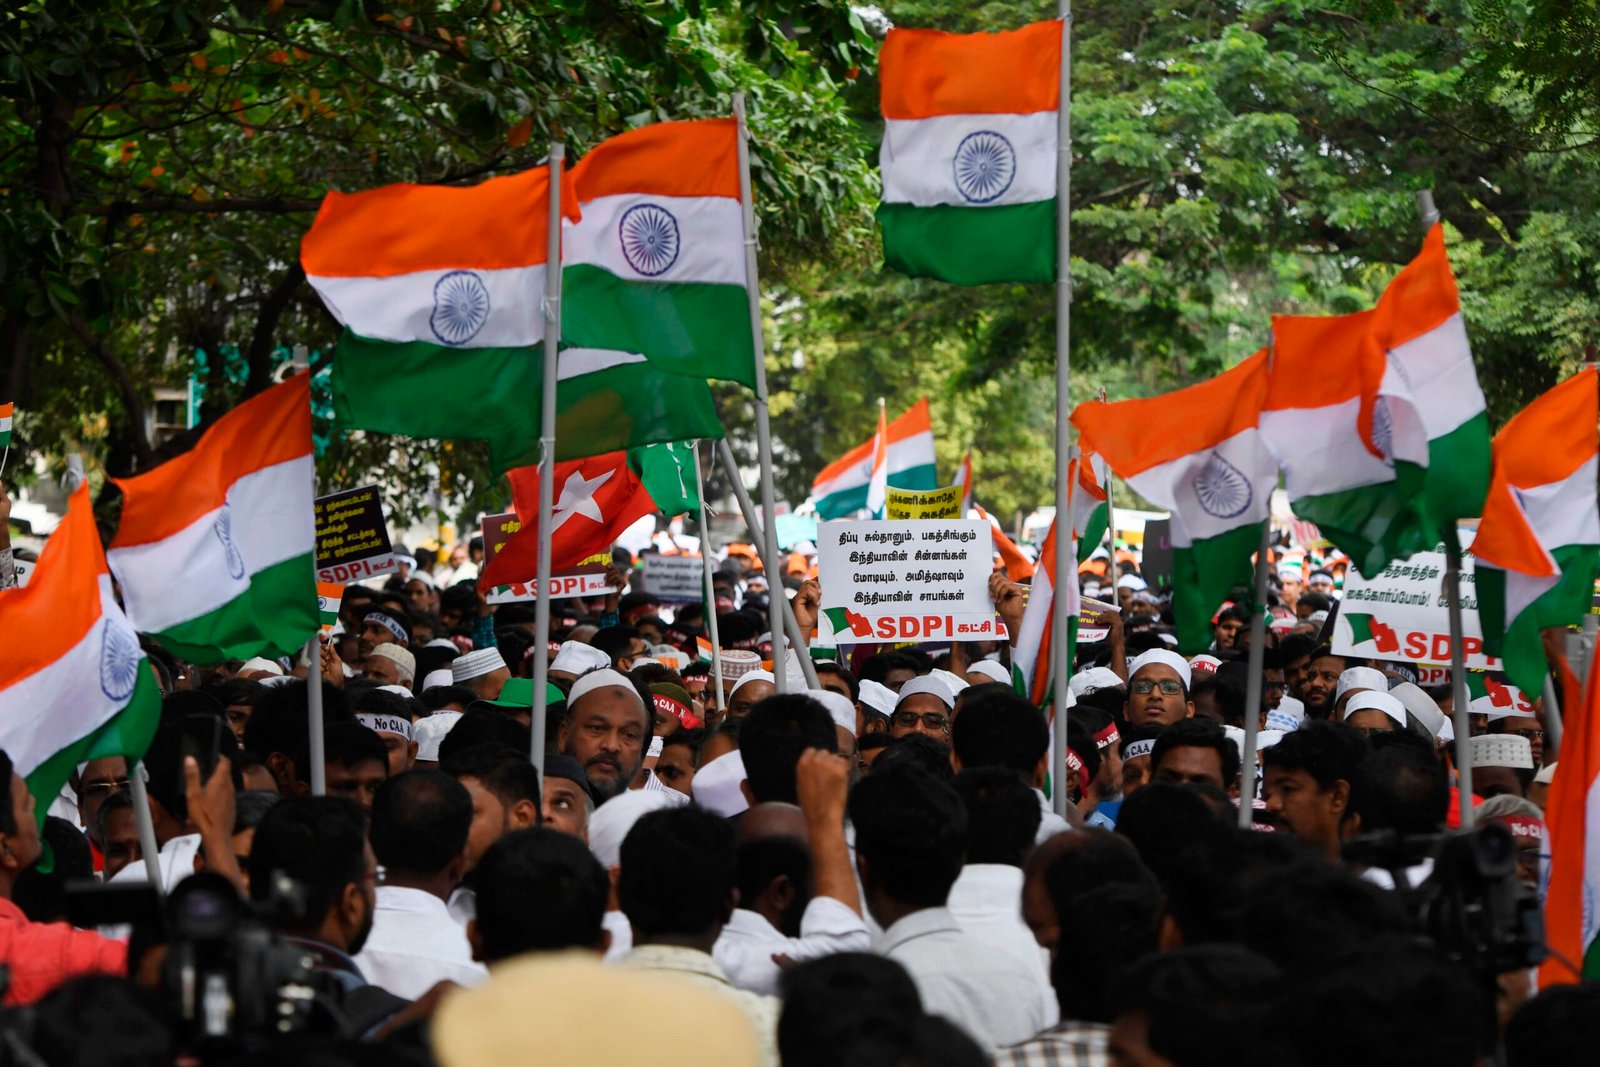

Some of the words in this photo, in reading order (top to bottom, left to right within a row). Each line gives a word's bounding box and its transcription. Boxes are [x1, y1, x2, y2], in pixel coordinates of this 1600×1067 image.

[839, 531, 858, 546] திப்பு
[921, 529, 977, 544] பகத்சிங்கும்
[849, 550, 908, 565] இந்தியாவின்
[914, 549, 968, 561] சின்னங்கள்
[319, 560, 372, 584] SDPI
[905, 569, 965, 584] அமித்ஷாவும்
[853, 590, 913, 605] இந்தியாவின்
[919, 589, 965, 601] சாபங்கள்
[876, 615, 954, 639] SDPI
[957, 620, 992, 633] கட்சி
[1203, 662, 1214, 672] No
[1418, 668, 1451, 683] DPI
[659, 699, 675, 713] CAA
[374, 718, 388, 731] No
[389, 719, 404, 733] CAA
[1130, 743, 1150, 756] CAA
[1511, 822, 1528, 836] No
